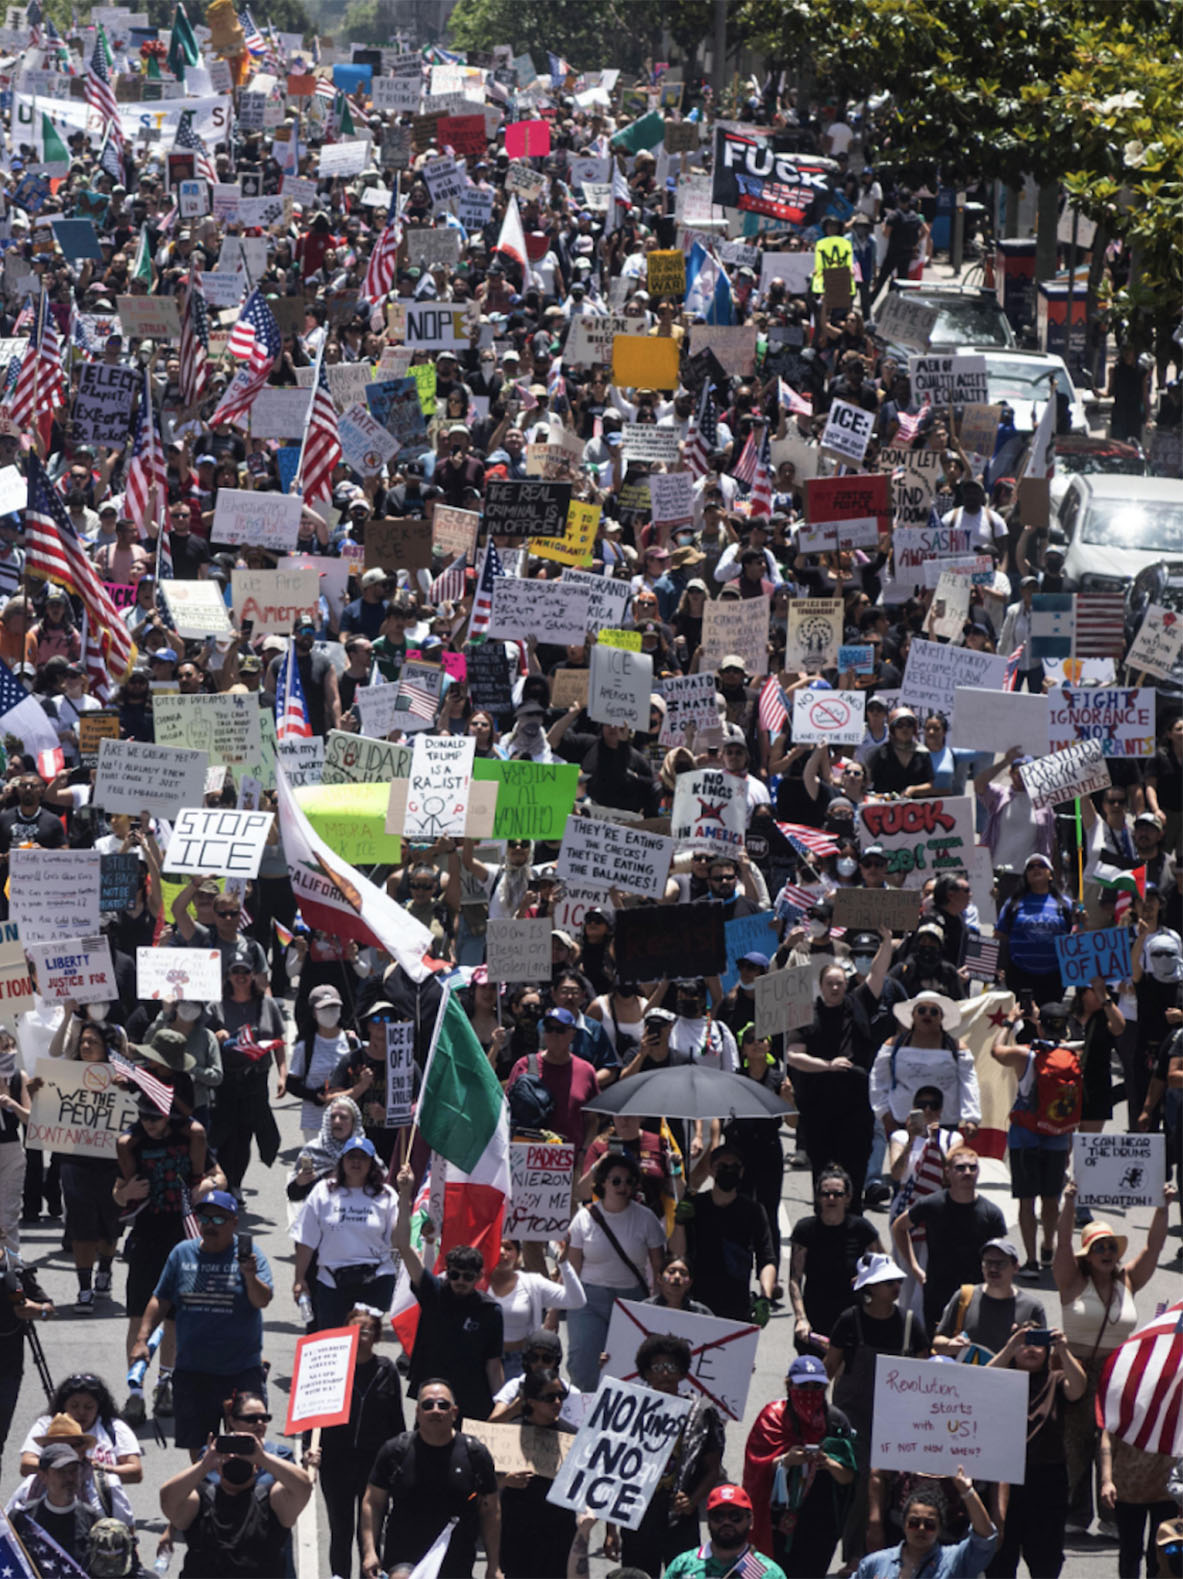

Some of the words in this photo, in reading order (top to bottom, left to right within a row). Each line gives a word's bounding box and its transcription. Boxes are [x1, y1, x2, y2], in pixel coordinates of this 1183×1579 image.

[379, 80, 410, 91] FUCK
[378, 92, 418, 104] TRUMP
[724, 141, 829, 191] FUCK
[433, 186, 462, 201] NOW!
[735, 173, 815, 209] TRUMP
[650, 279, 684, 294] WAR!
[917, 361, 940, 373] MEN
[942, 360, 953, 371] OF
[934, 389, 989, 404] EQUALITY
[832, 404, 869, 436] ICE:
[917, 451, 939, 467] LET
[489, 486, 510, 501] THE
[518, 485, 557, 503] REAL
[486, 503, 542, 519] CRIMINAL
[545, 505, 559, 520] IS
[488, 520, 501, 533] IN
[504, 516, 564, 537] OFFICE!
[275, 575, 304, 591] Are
[606, 652, 632, 676] ICE
[665, 675, 714, 692] UNPAID
[682, 697, 715, 710] HATE
[797, 691, 815, 712] NO
[838, 691, 865, 713] KINGS
[1070, 691, 1131, 709] FIGHT
[1049, 708, 1150, 726] IGNORANCE
[793, 734, 817, 744] LAND
[1079, 725, 1113, 740] NOT
[425, 738, 467, 750] DONALD
[425, 751, 461, 761] TRUMP
[430, 766, 442, 775] IS
[443, 766, 452, 775] A
[501, 763, 556, 785] MIGRA
[704, 773, 725, 785] NO
[692, 781, 733, 798] KINGS
[177, 812, 267, 837] STOP
[494, 805, 553, 838] CHINGA
[861, 800, 956, 838] FUCK
[573, 819, 619, 842] THEY'RE
[625, 832, 664, 851] EATING
[678, 826, 692, 838] IN
[695, 826, 744, 848] AMERICA
[170, 838, 257, 871] ICE
[585, 838, 602, 849] THE
[603, 843, 647, 860] CHECKS!
[567, 847, 608, 867] THEY'RE
[614, 858, 655, 876] EATING
[568, 863, 588, 876] THE
[592, 869, 658, 892] BALANCES!
[1059, 933, 1090, 952] ICE
[1095, 928, 1128, 949] OUT
[45, 954, 90, 970] LIBERTY
[1065, 957, 1092, 980] OF
[1095, 954, 1132, 978] LA!
[47, 974, 85, 989] JUSTICE
[89, 973, 107, 985] FOR
[56, 987, 71, 997] ALL
[90, 1090, 116, 1109] THE
[58, 1101, 135, 1132] PEOPLE
[64, 1127, 114, 1148] ANSWER
[1092, 1137, 1116, 1147] CAN
[1121, 1137, 1151, 1147] HEAR
[526, 1146, 575, 1168] PADRES
[1084, 1156, 1099, 1168] OF
[1088, 1147, 1111, 1158] THE
[1112, 1147, 1152, 1159] DRUMS
[548, 1192, 571, 1209] ME
[1078, 1195, 1153, 1207] LIBERATION!
[526, 1215, 572, 1233] TODO
[181, 1261, 198, 1272] NEW
[200, 1263, 221, 1273] YORK
[885, 1369, 960, 1399] Revolution
[588, 1388, 634, 1434] NO
[930, 1401, 973, 1415] starts
[946, 1419, 978, 1439] US!
[897, 1442, 918, 1454] NOT
[950, 1445, 981, 1457] WHEN?
[589, 1439, 644, 1481] NO
[567, 1471, 643, 1522] ICE
